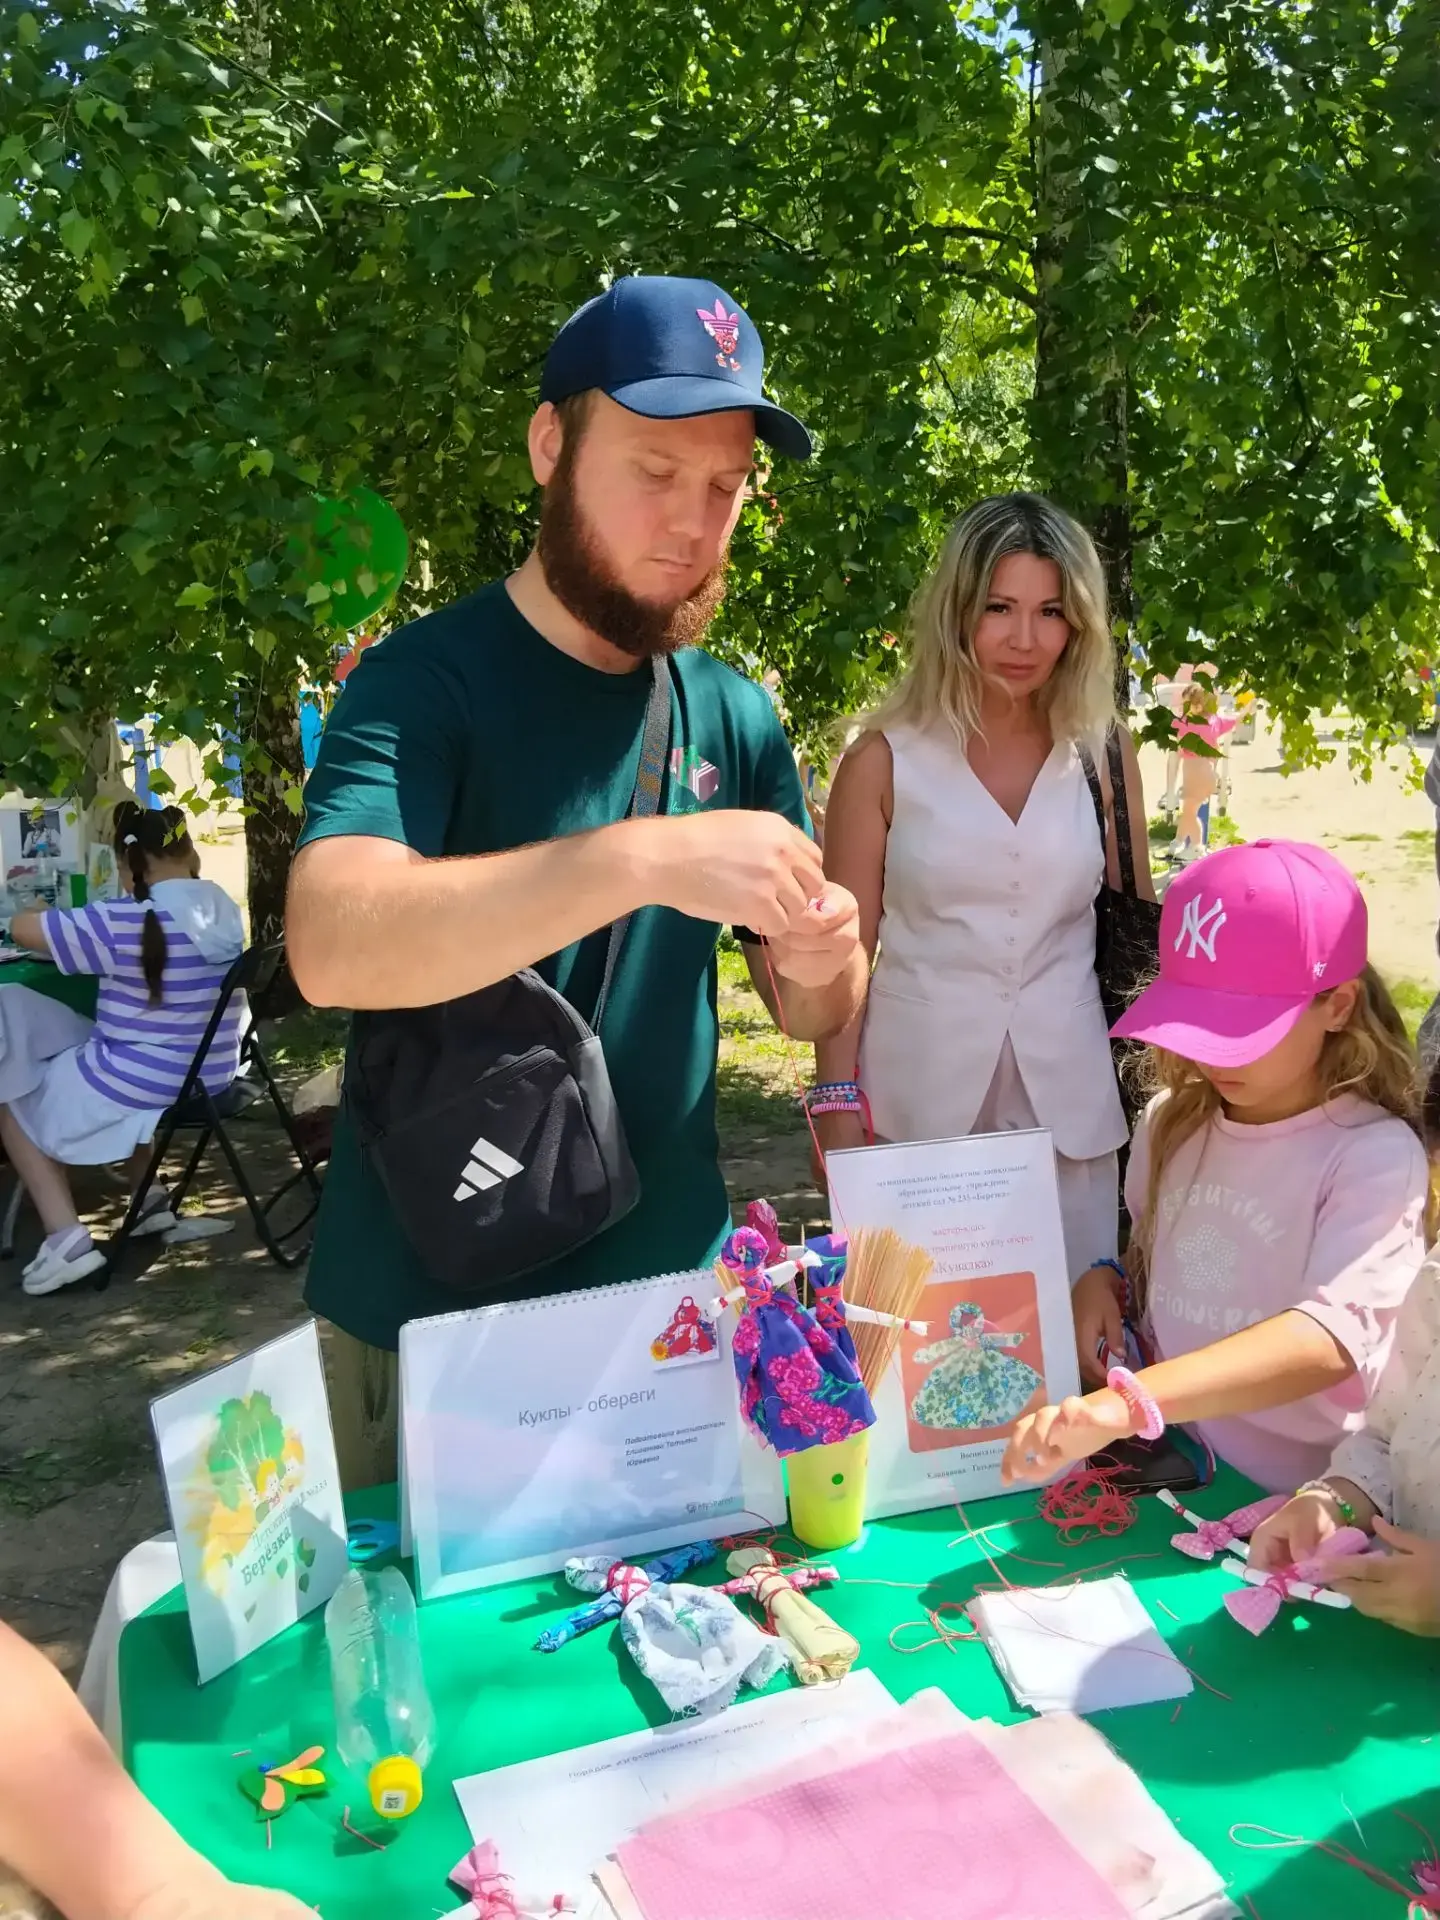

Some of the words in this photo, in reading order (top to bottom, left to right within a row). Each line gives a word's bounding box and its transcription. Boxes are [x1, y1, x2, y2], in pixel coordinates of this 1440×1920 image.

[518, 1405, 571, 1428] Куклы
[588, 1387, 656, 1414] обереги
[241, 1526, 291, 1586] Берёзка
